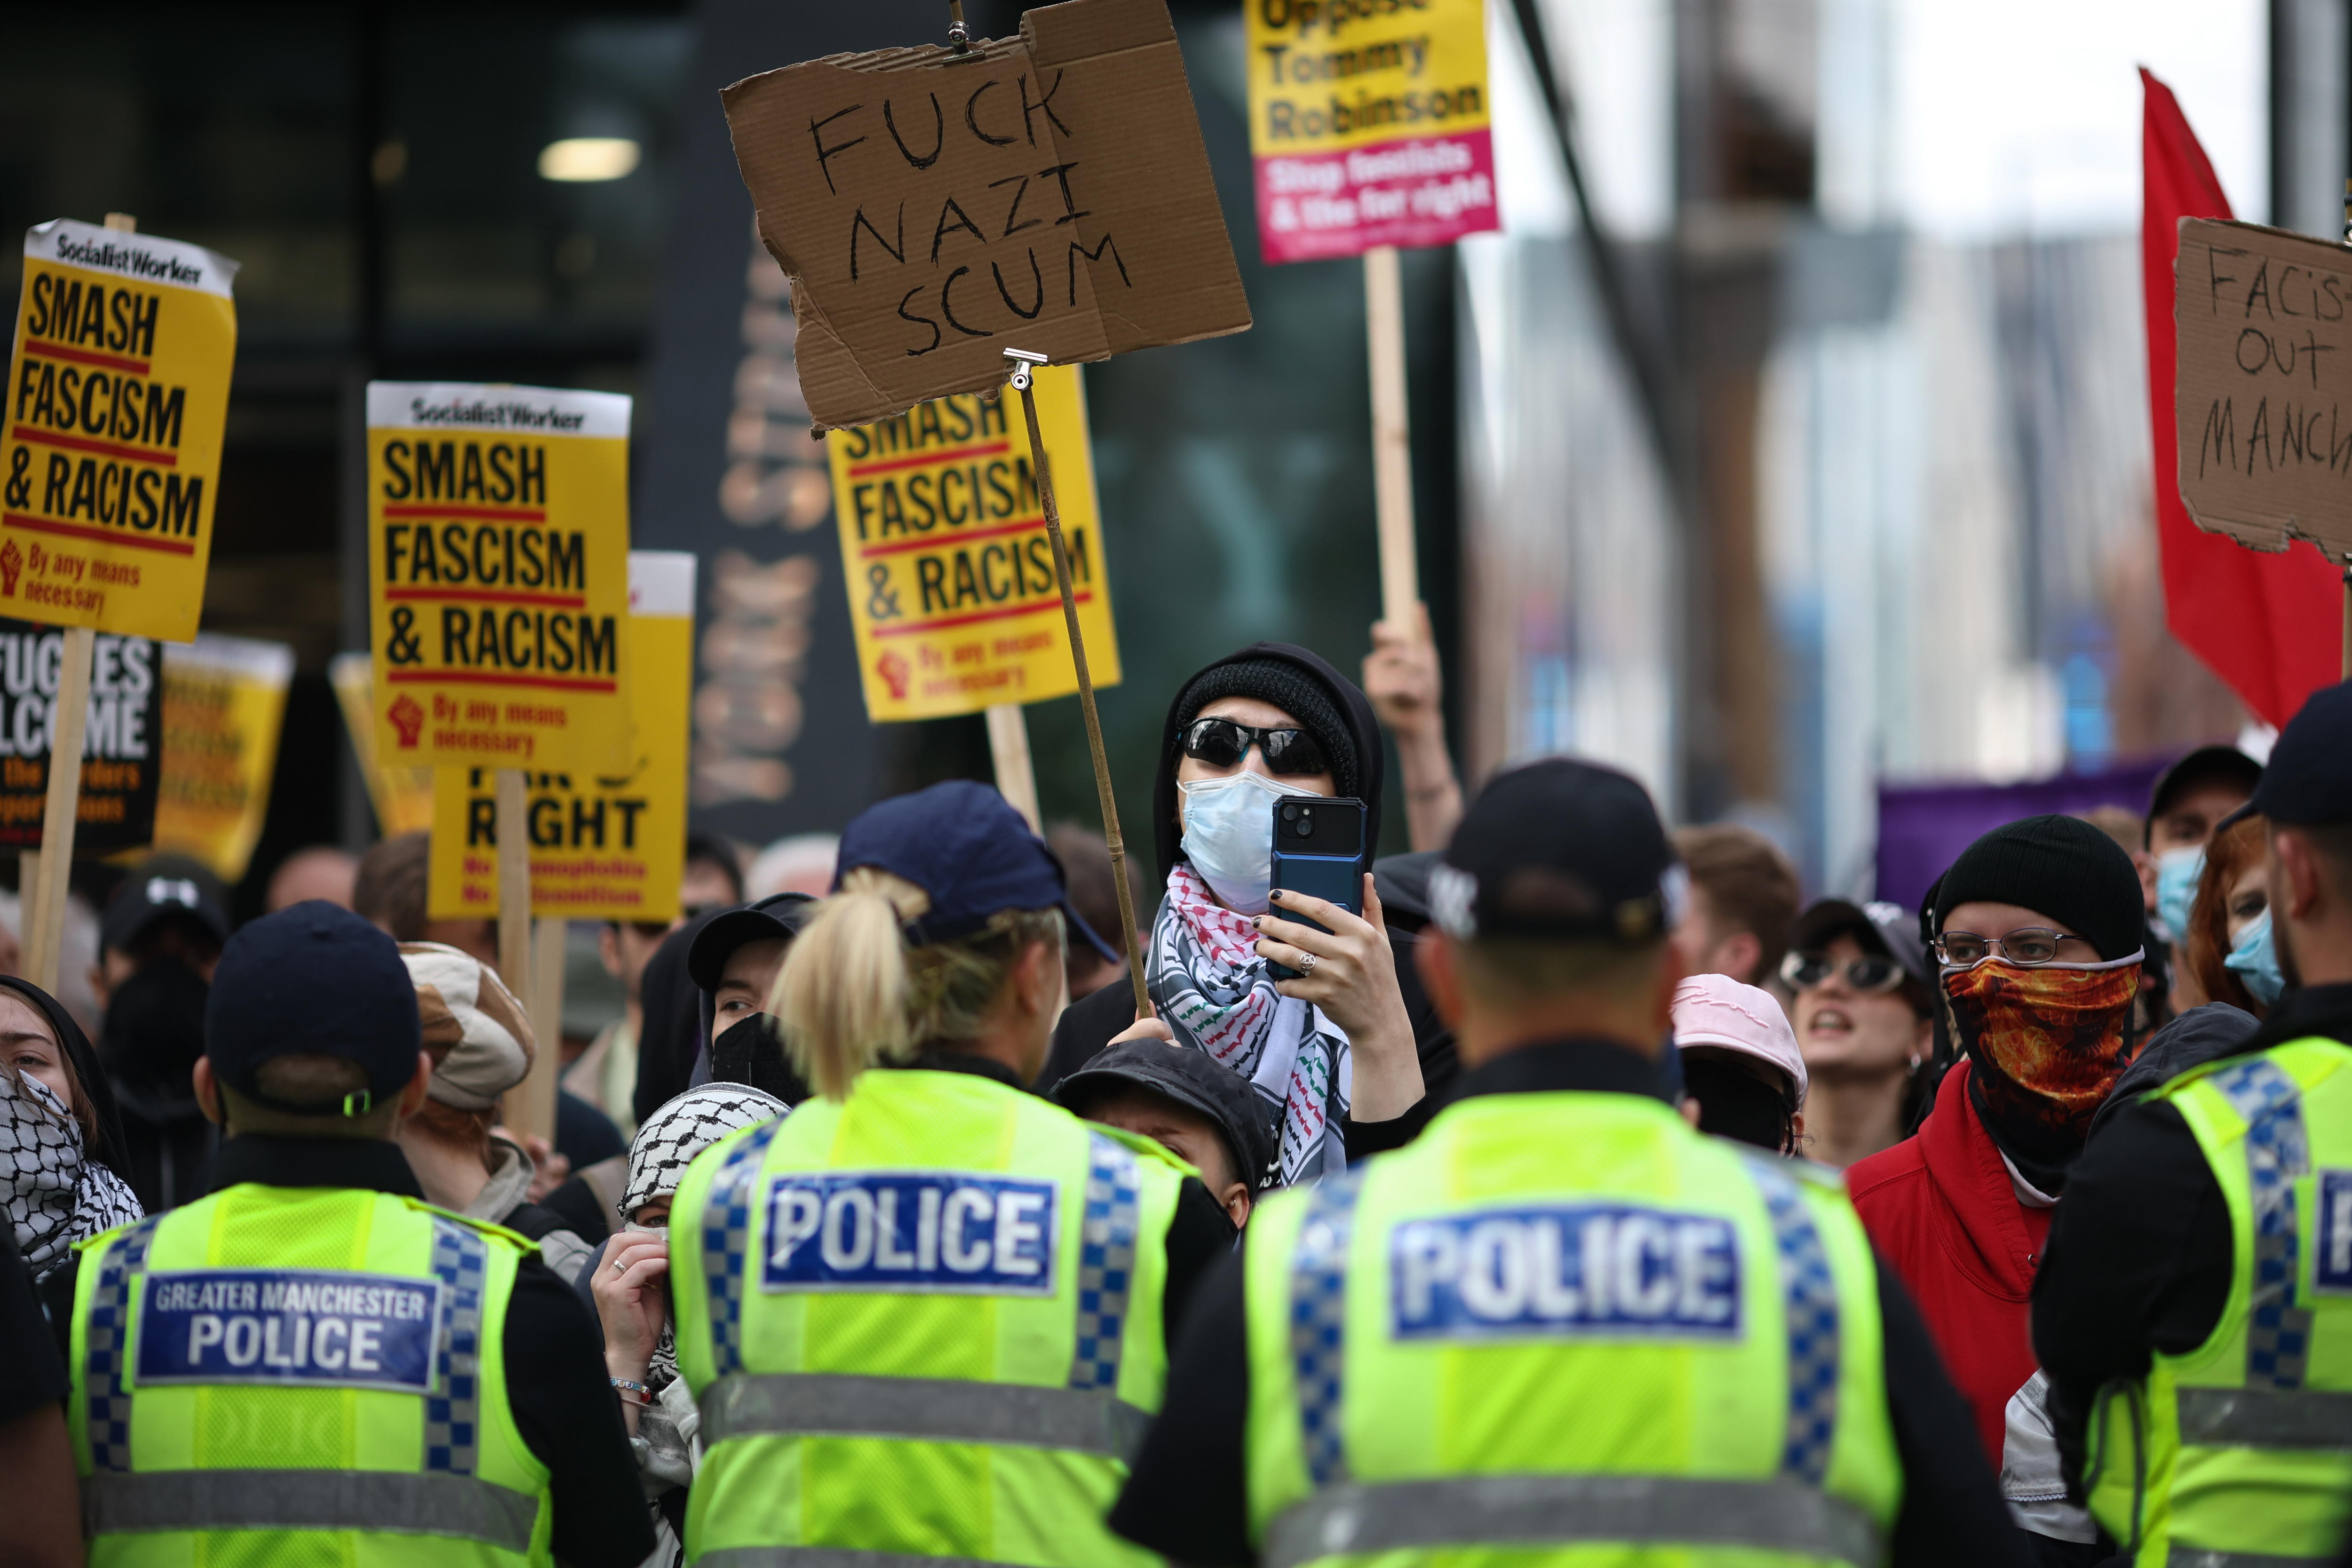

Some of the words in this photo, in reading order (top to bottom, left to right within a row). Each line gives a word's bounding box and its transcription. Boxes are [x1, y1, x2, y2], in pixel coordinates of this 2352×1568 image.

[1263, 36, 1429, 84] Tommy
[808, 68, 1072, 195] FUCK
[1267, 85, 1481, 137] Robinson
[1268, 159, 1344, 197] Stop
[1412, 174, 1490, 220] right
[850, 162, 1091, 283] NAZI
[56, 233, 130, 270] Socialist
[132, 251, 202, 286] Worker
[28, 272, 160, 357] SMASH
[898, 233, 1131, 357] SCUM
[16, 359, 186, 448] FASCISM
[412, 397, 505, 426] Socialist
[509, 400, 587, 431] Worker
[845, 394, 1009, 460] SMASH
[5, 446, 32, 511] &
[43, 453, 204, 538] RACISM
[383, 440, 546, 505] SMASH
[28, 543, 49, 575] By
[53, 553, 87, 583] any
[90, 556, 141, 588] means
[384, 523, 585, 590] FASCISM
[866, 564, 901, 620] &
[917, 527, 1091, 614] RACISM
[24, 580, 106, 620] necessary
[386, 606, 424, 666] &
[441, 607, 617, 675] RACISM
[434, 694, 458, 723] By
[467, 697, 499, 725] any
[506, 701, 567, 728] means
[434, 729, 534, 758] necessary
[467, 798, 647, 848] RGHT
[771, 1186, 1045, 1275] POLICE
[1400, 1216, 1734, 1321] POLICE
[156, 1282, 255, 1312] GREATER
[262, 1284, 425, 1320] MANCHESTER
[188, 1313, 383, 1371] POLICE
